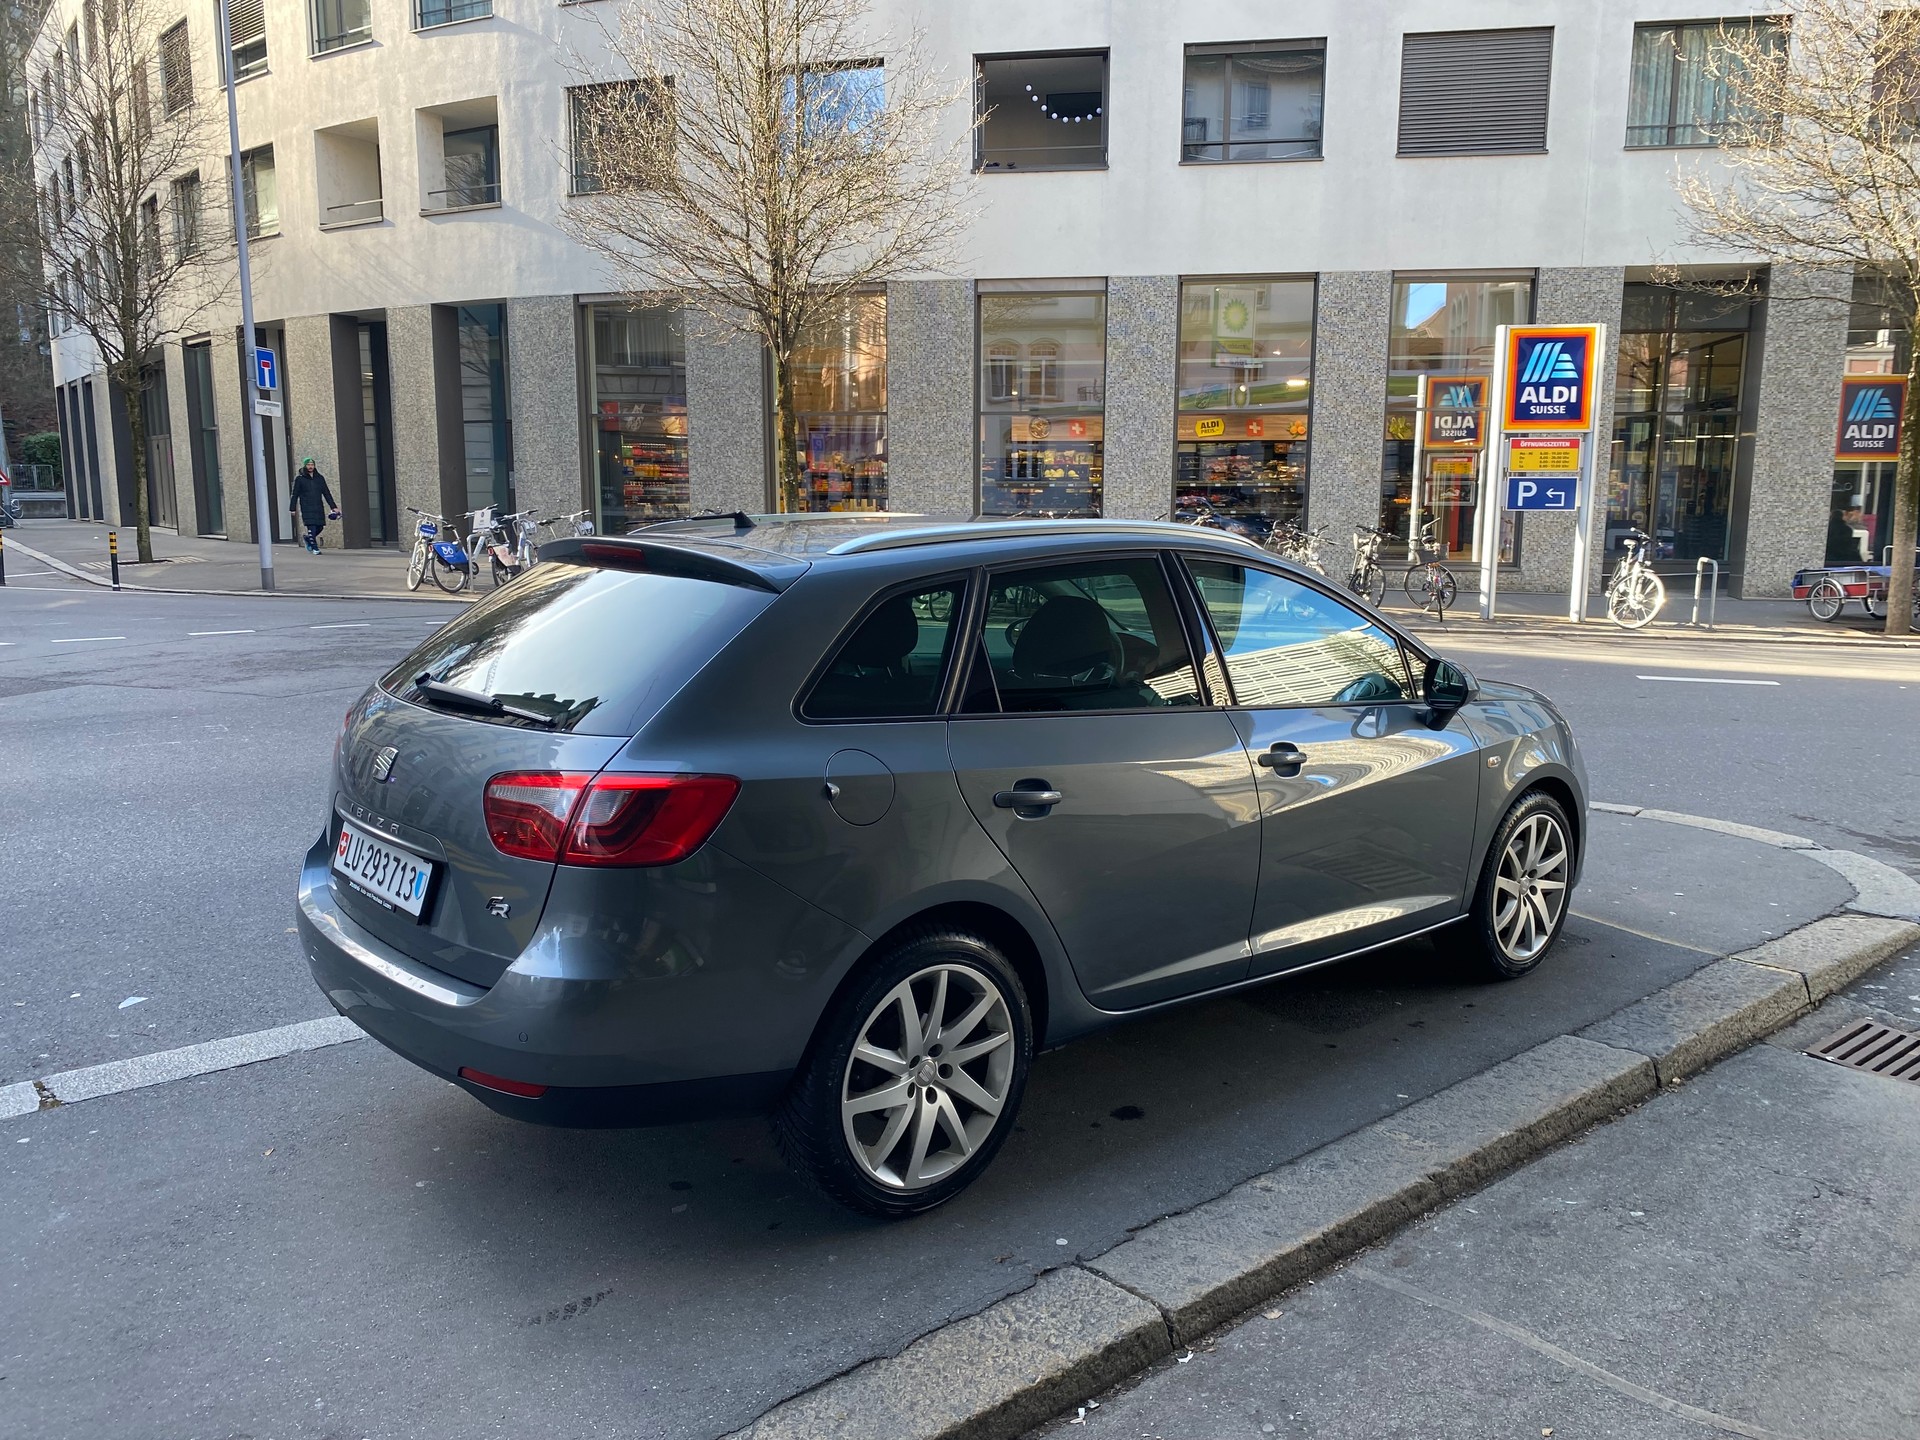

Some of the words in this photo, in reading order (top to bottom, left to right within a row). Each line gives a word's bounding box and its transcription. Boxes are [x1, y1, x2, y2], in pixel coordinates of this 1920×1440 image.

[1520, 386, 1577, 403] ALDI
[1529, 405, 1566, 414] SUISSE
[1201, 420, 1219, 429] ALDI
[1844, 424, 1895, 439] ALDI
[1853, 440, 1885, 448] SUISSE
[1517, 481, 1537, 507] P
